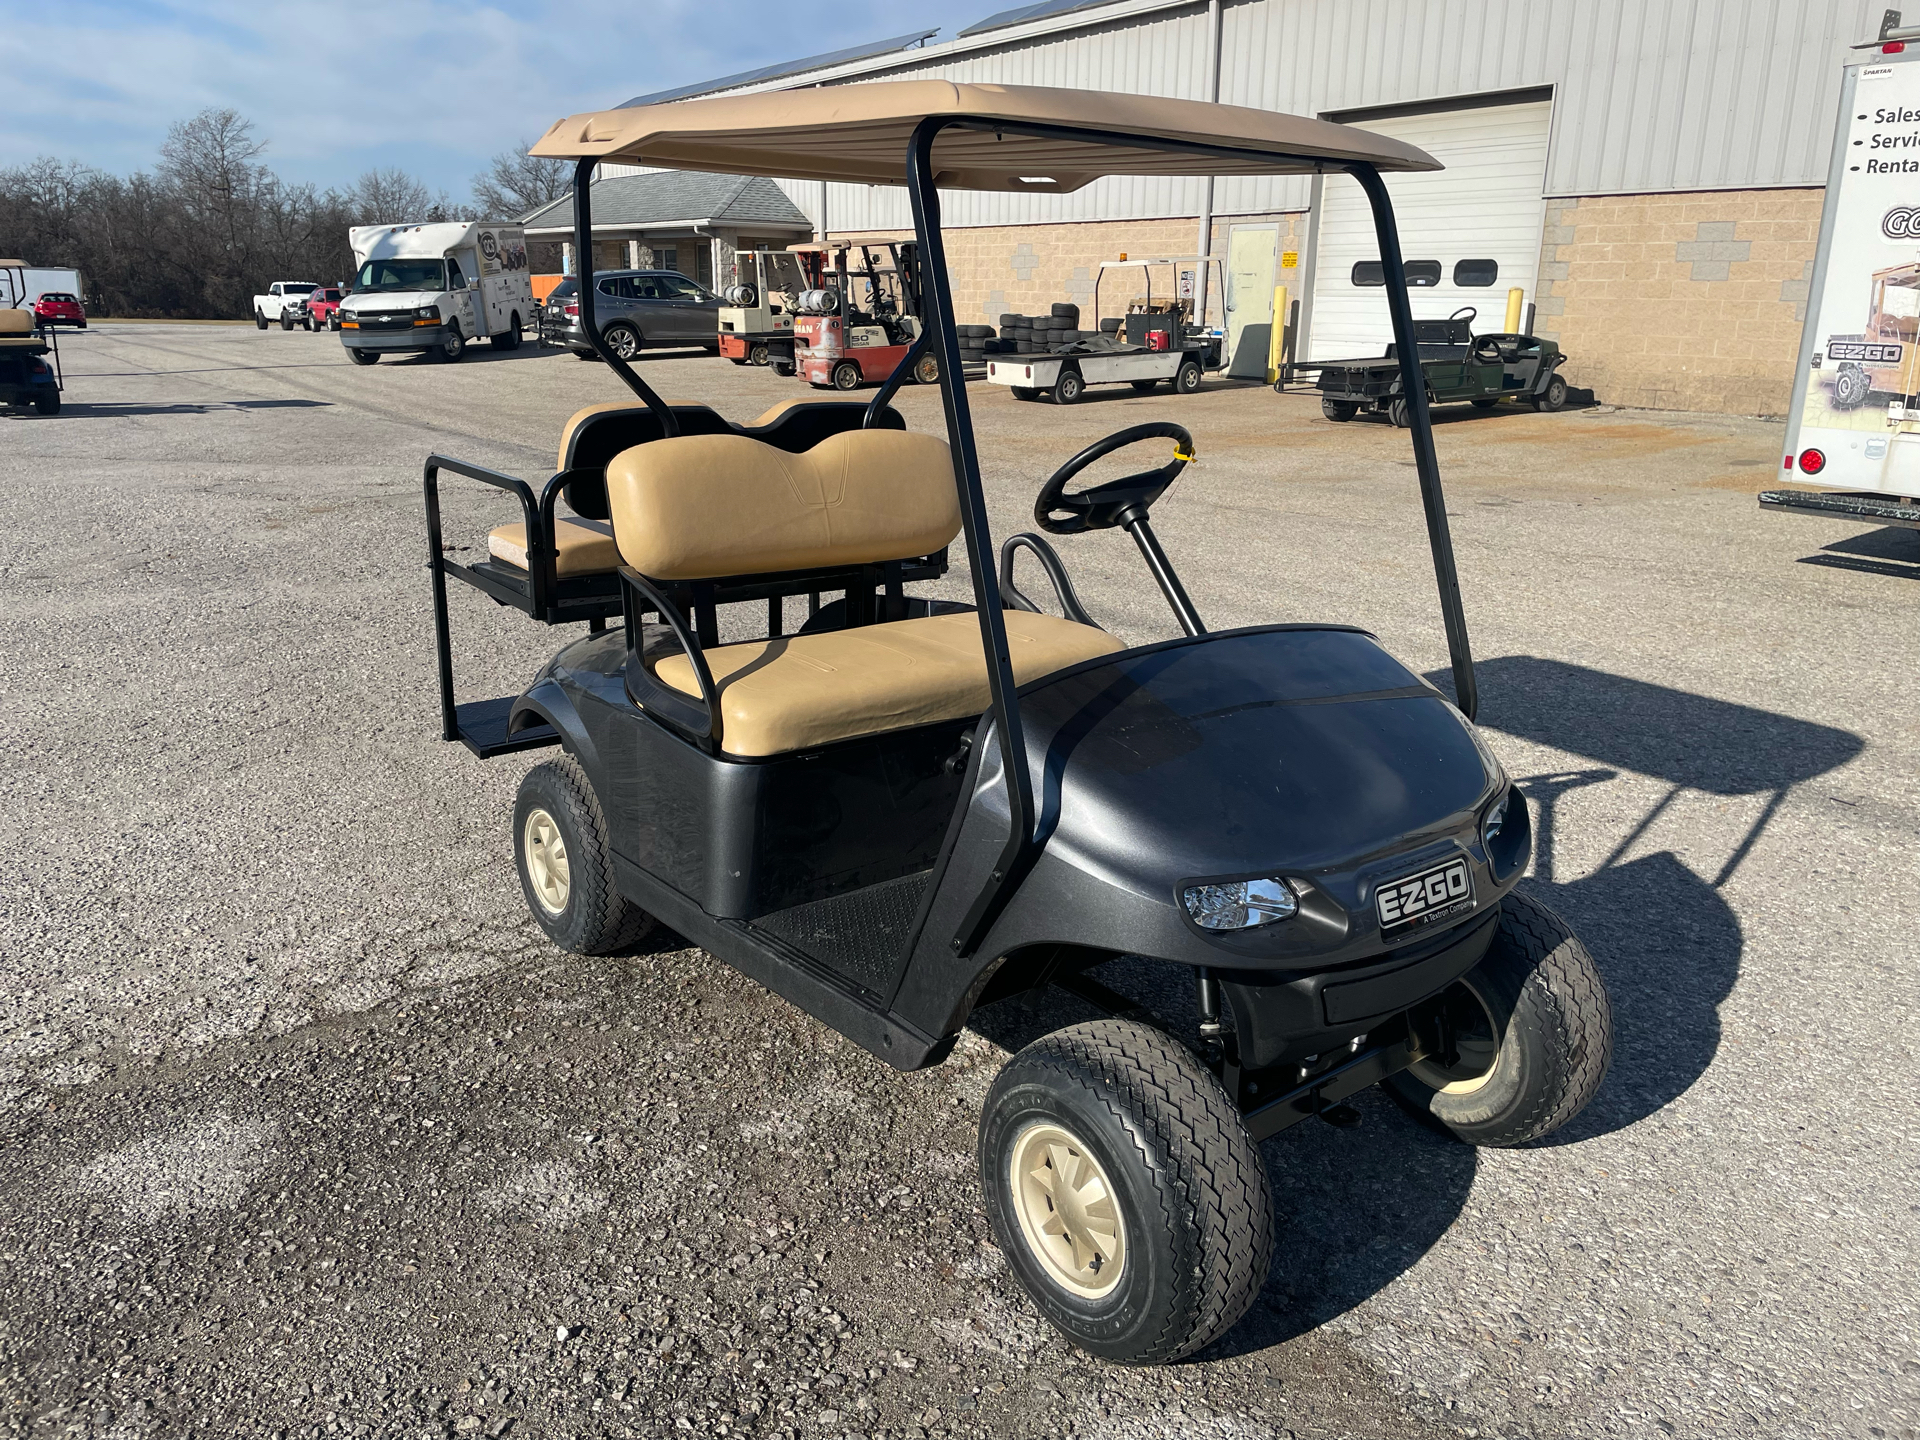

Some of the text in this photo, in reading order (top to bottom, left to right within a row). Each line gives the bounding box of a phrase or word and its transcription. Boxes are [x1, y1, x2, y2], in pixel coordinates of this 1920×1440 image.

[1863, 68, 1893, 76] SPARTAN
[1874, 106, 1920, 124] Sales
[1829, 343, 1902, 362] EZGO
[1377, 865, 1467, 922] EZGO
[1423, 900, 1474, 924] A Textron Company
